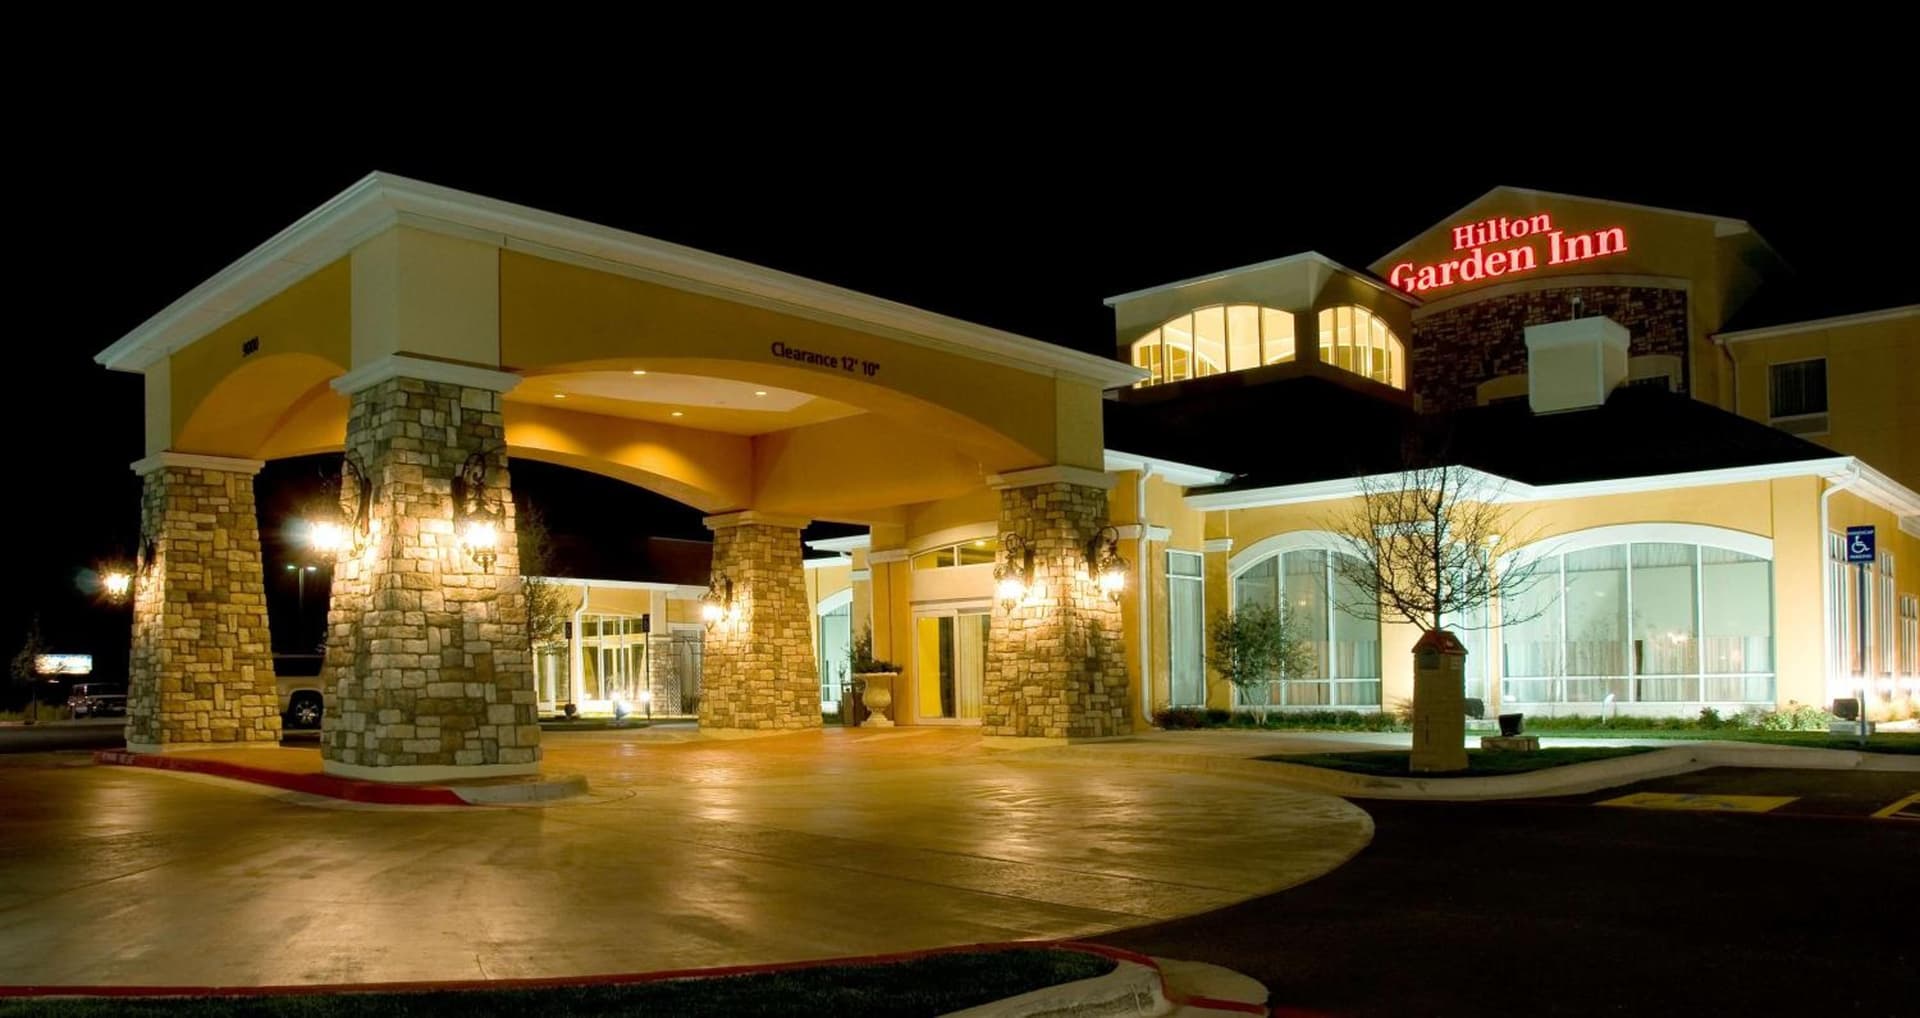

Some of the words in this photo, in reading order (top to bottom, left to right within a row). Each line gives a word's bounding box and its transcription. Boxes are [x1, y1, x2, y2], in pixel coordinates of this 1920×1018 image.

[1452, 213, 1552, 250] Hilton
[1389, 245, 1536, 293] Garden
[1547, 227, 1628, 266] Inn
[771, 341, 838, 369] Clearance
[840, 355, 858, 372] 12'
